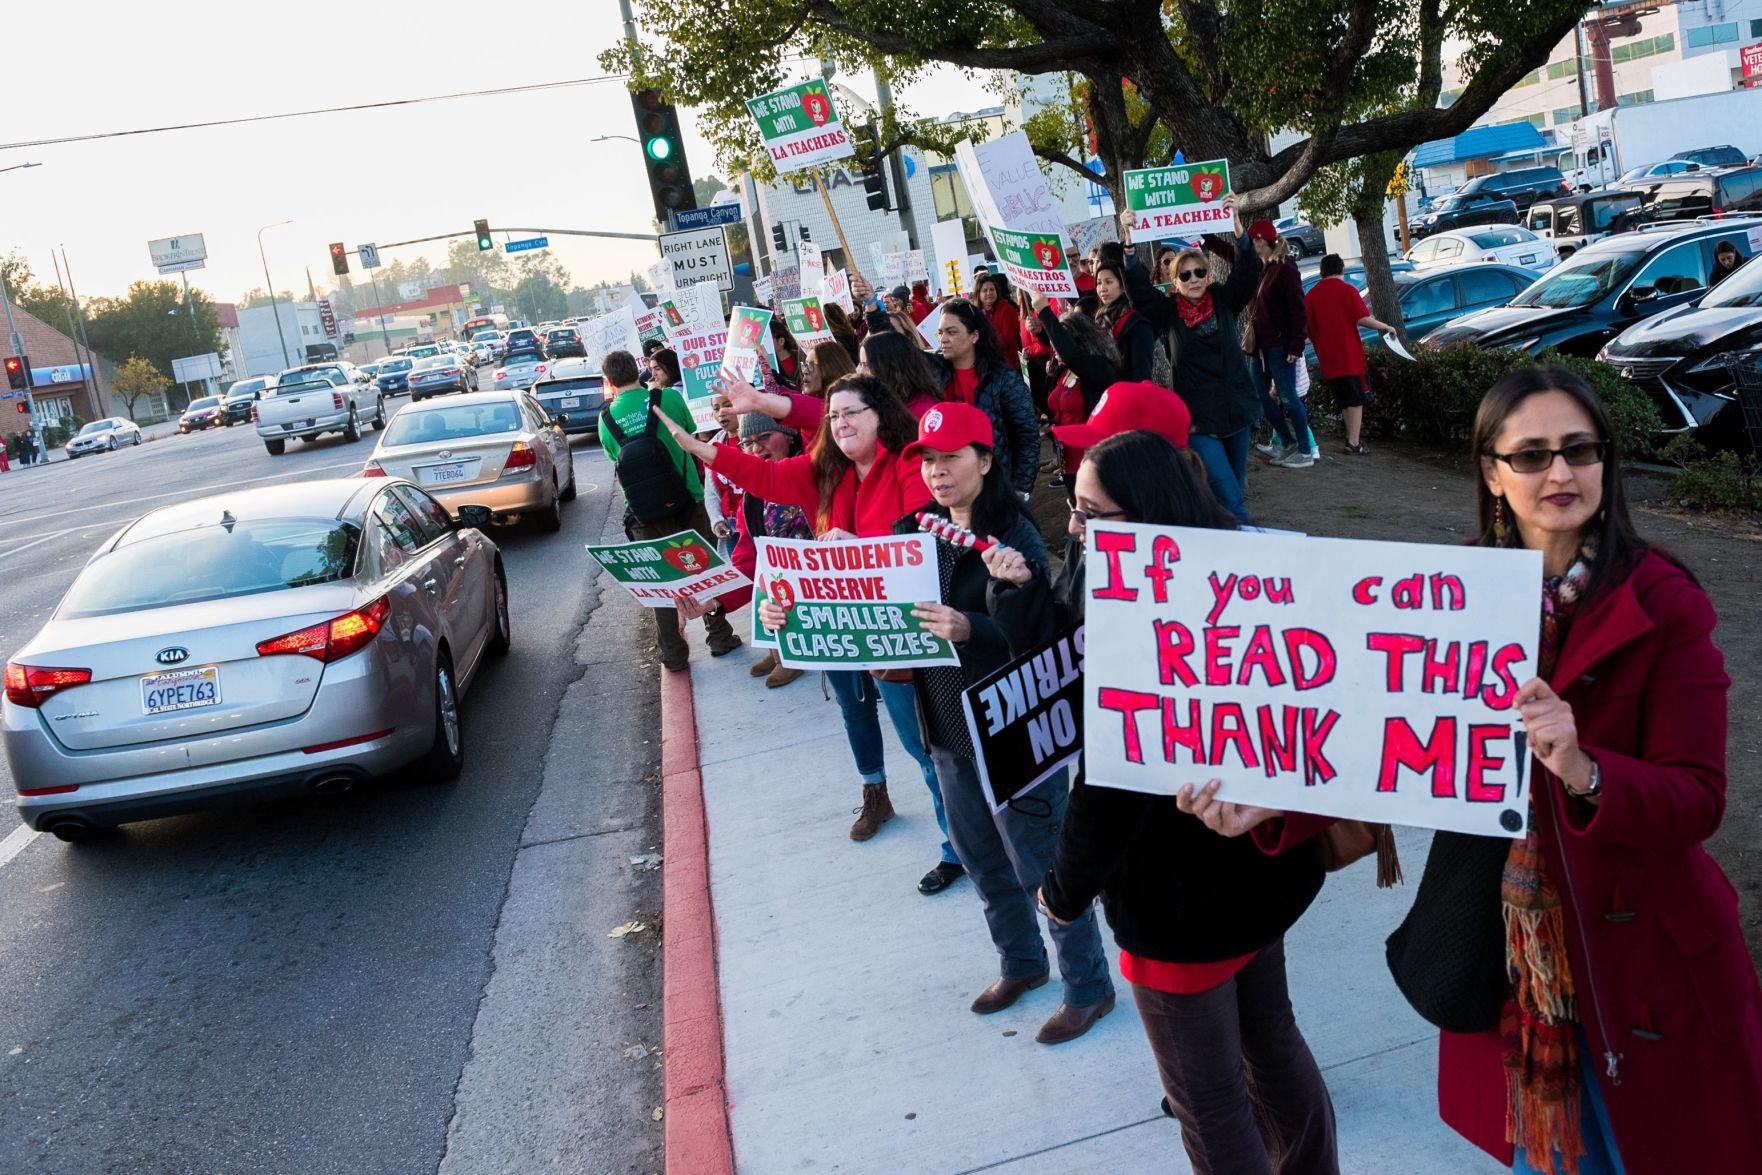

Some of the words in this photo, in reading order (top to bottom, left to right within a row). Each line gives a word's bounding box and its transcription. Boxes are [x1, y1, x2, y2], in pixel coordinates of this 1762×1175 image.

[752, 101, 770, 118] WE
[769, 92, 801, 113] STAND
[773, 114, 797, 133] WITH
[771, 145, 788, 160] LA
[787, 130, 846, 156] TEACHERS
[1128, 174, 1144, 190] WE
[1148, 170, 1189, 187] STAND
[1145, 190, 1176, 207] WITH
[677, 210, 708, 224] Topanga
[711, 206, 738, 218] Canyon
[1154, 207, 1231, 227] TEACHERS
[507, 240, 532, 250] Topanga
[535, 238, 547, 247] Cyn
[664, 241, 693, 254] RIGHT
[696, 237, 722, 249] LANE
[993, 229, 1030, 250] ESTAMOS
[674, 255, 717, 271] MUST
[675, 277, 696, 289] URN
[1017, 268, 1066, 281] MAESTROS
[1037, 283, 1072, 293] GELES
[683, 336, 707, 351] OUR
[594, 550, 618, 564] WE
[614, 547, 661, 563] STAND
[766, 544, 802, 571] OUR
[803, 540, 923, 571] STUDENTS
[624, 566, 660, 580] WITH
[1093, 530, 1181, 603] If
[1205, 570, 1295, 627] you
[1352, 571, 1466, 612] can
[629, 588, 654, 598] LA
[649, 570, 739, 599] TEACHERS
[799, 576, 887, 600] DESERVE
[797, 606, 908, 630] SMALLER
[786, 632, 860, 657] CLASS
[866, 632, 940, 656] SIZES
[159, 652, 185, 662] KIA
[1153, 618, 1337, 691] READ
[1367, 632, 1528, 712] THIS
[147, 682, 216, 708] 6YPE763
[1027, 699, 1076, 765] ON
[1098, 686, 1341, 787] THANK
